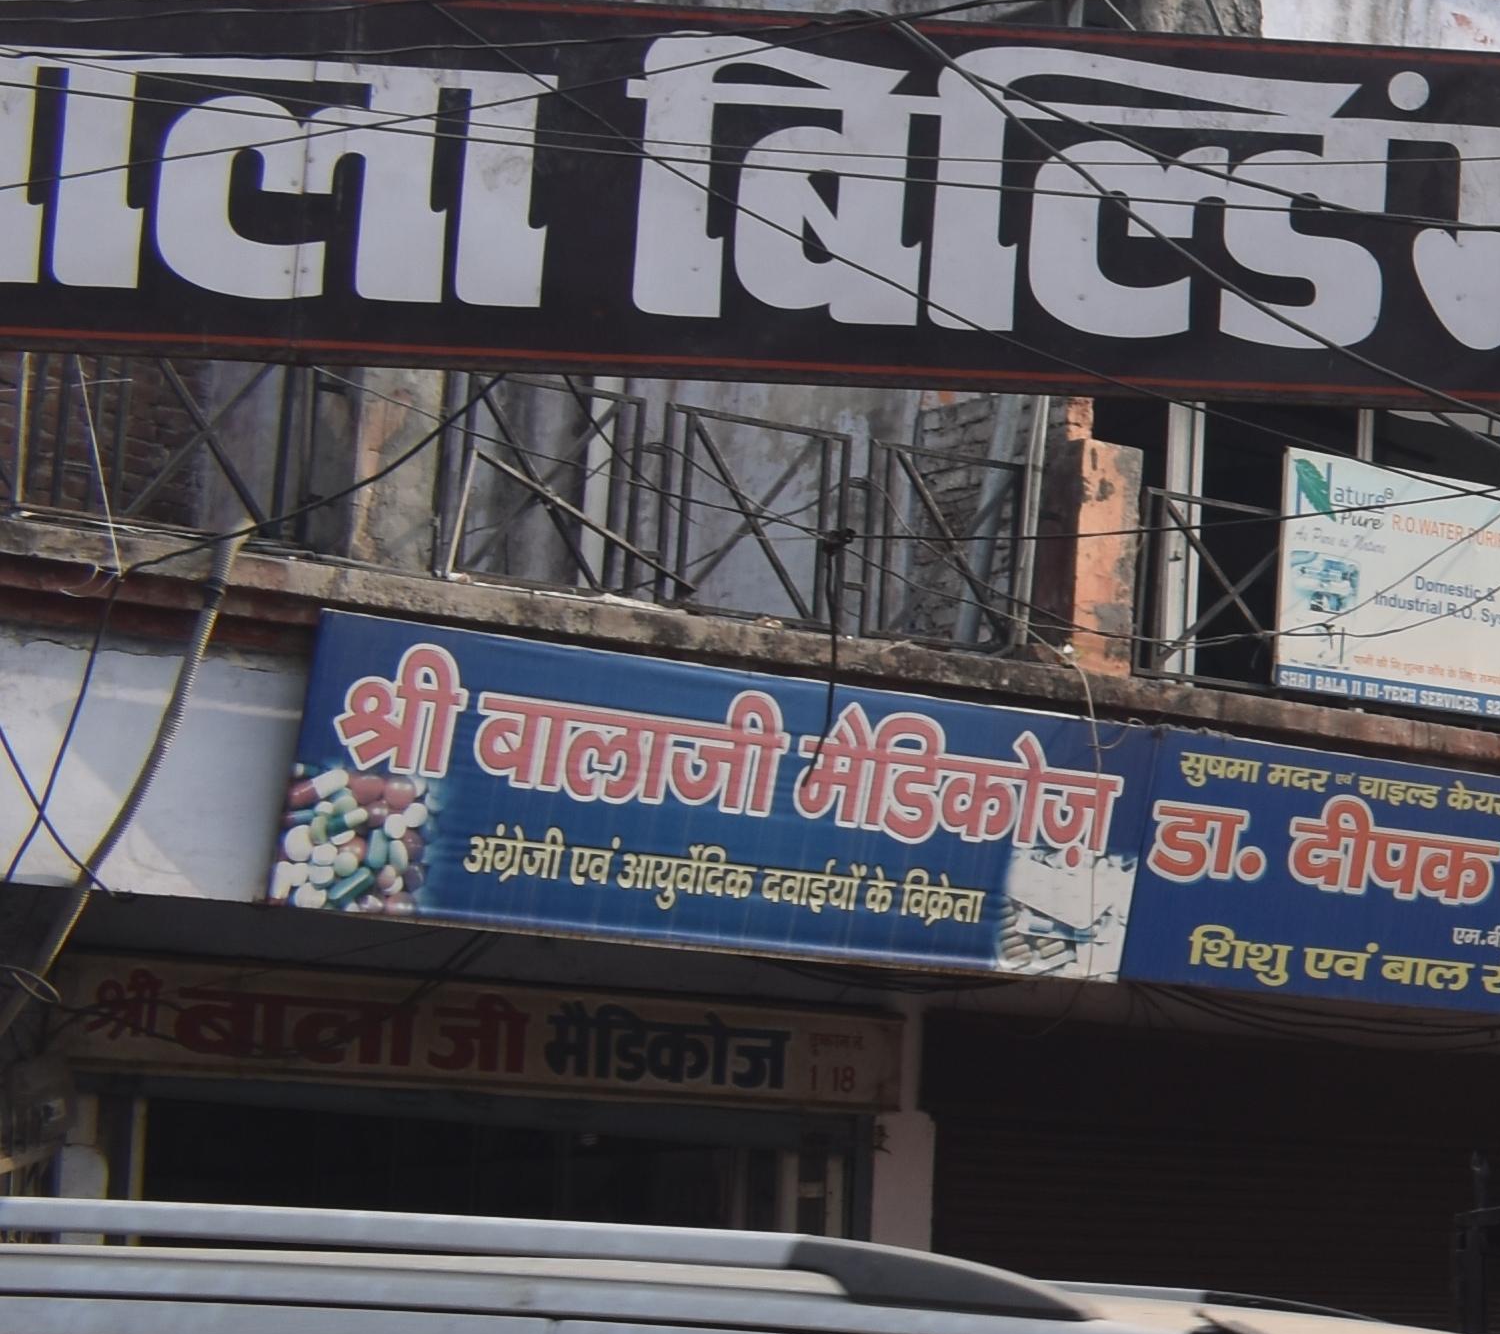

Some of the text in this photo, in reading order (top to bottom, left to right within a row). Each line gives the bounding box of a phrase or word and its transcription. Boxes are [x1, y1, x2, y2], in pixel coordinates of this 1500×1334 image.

[0, 39, 558, 309] ाला
[1414, 574, 1481, 601] Domestic
[333, 643, 468, 779] श्री
[474, 690, 789, 817] बालाजी
[1179, 750, 1260, 786] सुषमा
[1267, 764, 1331, 794] मदर
[1357, 773, 1442, 809] चाइल्ड
[463, 823, 986, 929] अंग्रेजी एवं आयुर्वेदिक दवाईयों के विक्रेता
[1152, 798, 1268, 883] डा.
[1189, 923, 1290, 987] शिशु
[1303, 942, 1380, 982] एवं
[1380, 950, 1471, 992] बाल
[430, 992, 532, 1076] जी
[543, 1001, 792, 1093] मैडिकोज
